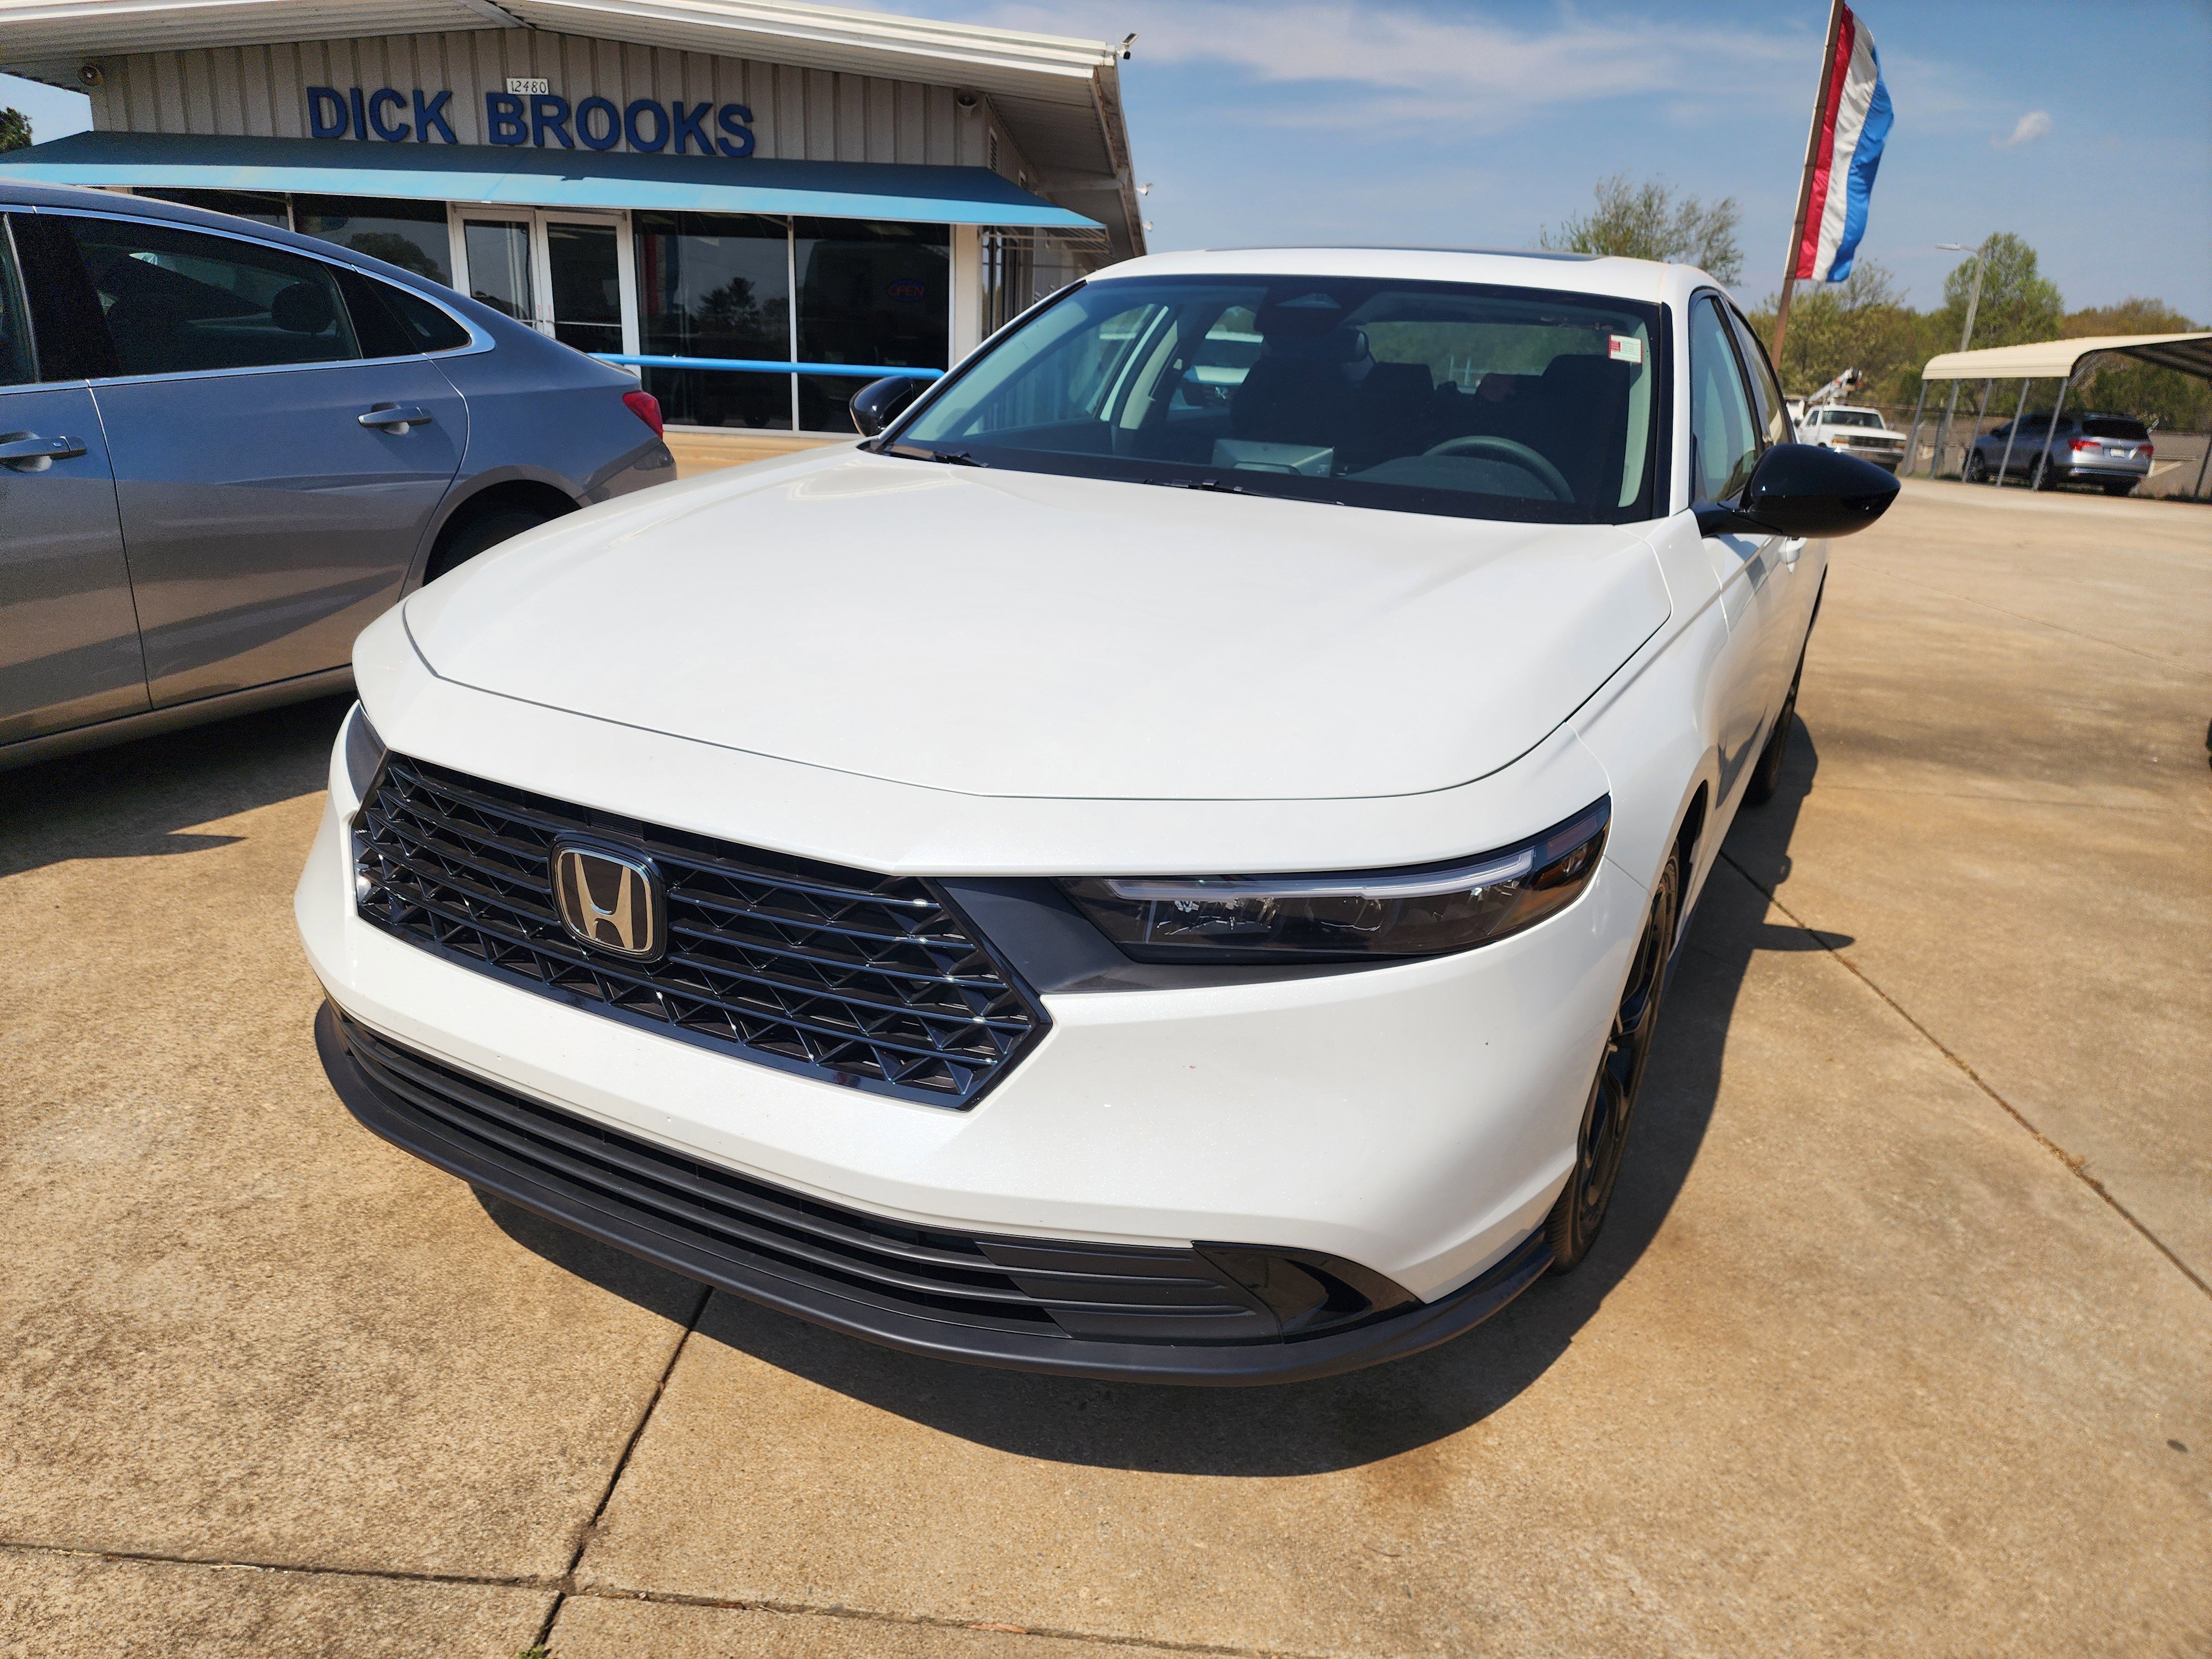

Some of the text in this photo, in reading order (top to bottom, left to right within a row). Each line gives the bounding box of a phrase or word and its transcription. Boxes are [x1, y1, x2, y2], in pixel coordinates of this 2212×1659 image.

[510, 80, 546, 93] 12480
[307, 87, 755, 158] DICK BROOKS
[888, 285, 924, 296] OPEN
